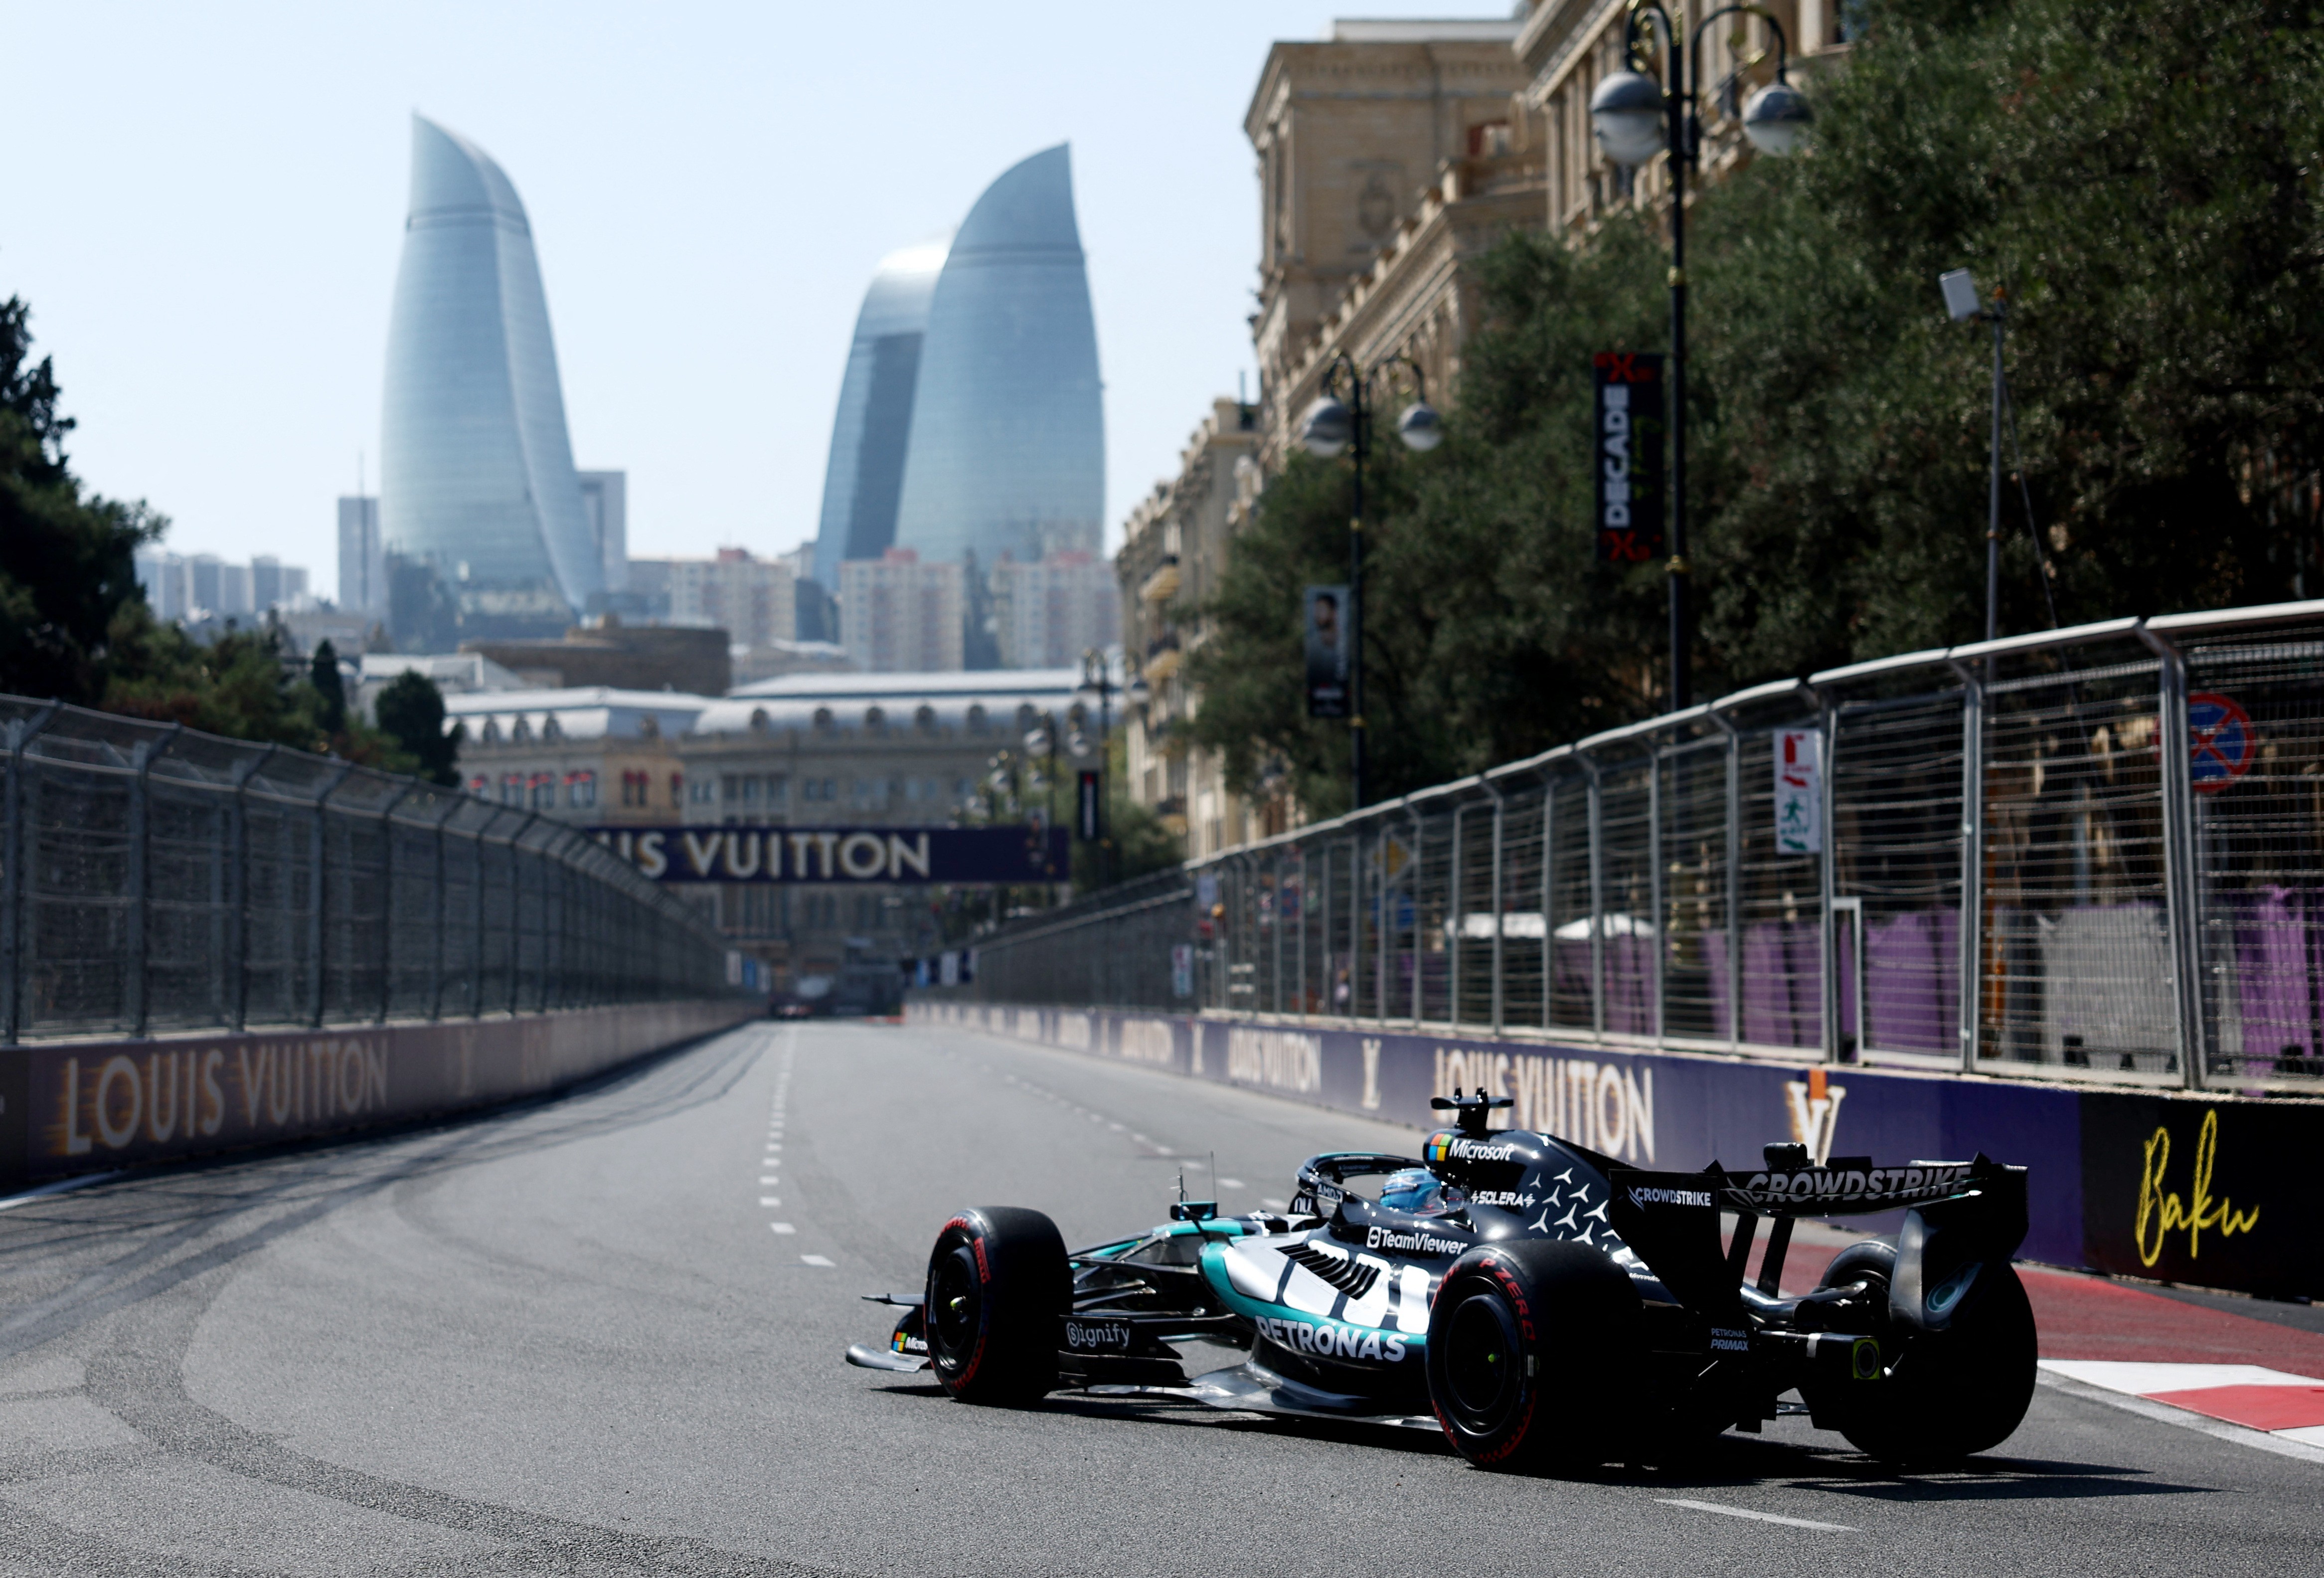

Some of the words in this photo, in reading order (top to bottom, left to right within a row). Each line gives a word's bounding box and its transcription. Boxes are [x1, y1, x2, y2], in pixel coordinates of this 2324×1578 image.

[685, 831, 930, 878] VUITTON
[65, 1048, 226, 1155] LOUIS
[238, 1036, 389, 1127] VUITTON
[1514, 1054, 1656, 1165] VUITTON
[1449, 1138, 1516, 1162] Microsoft
[1477, 1190, 1524, 1207] SOLERA
[1635, 1187, 1711, 1207] CROWDSTRIKE
[1747, 1167, 1972, 1204] CROWDSTRIKE
[2134, 1107, 2260, 1267] Baku
[1382, 1228, 1468, 1255] TeamViewer
[1479, 1257, 1496, 1268] P
[1494, 1267, 1536, 1341] ZERO
[1066, 1322, 1130, 1348] signify
[1255, 1315, 1410, 1362] PETRONAS
[1710, 1339, 1749, 1351] PRIMAX
[1711, 1328, 1747, 1338] PETRONAS
